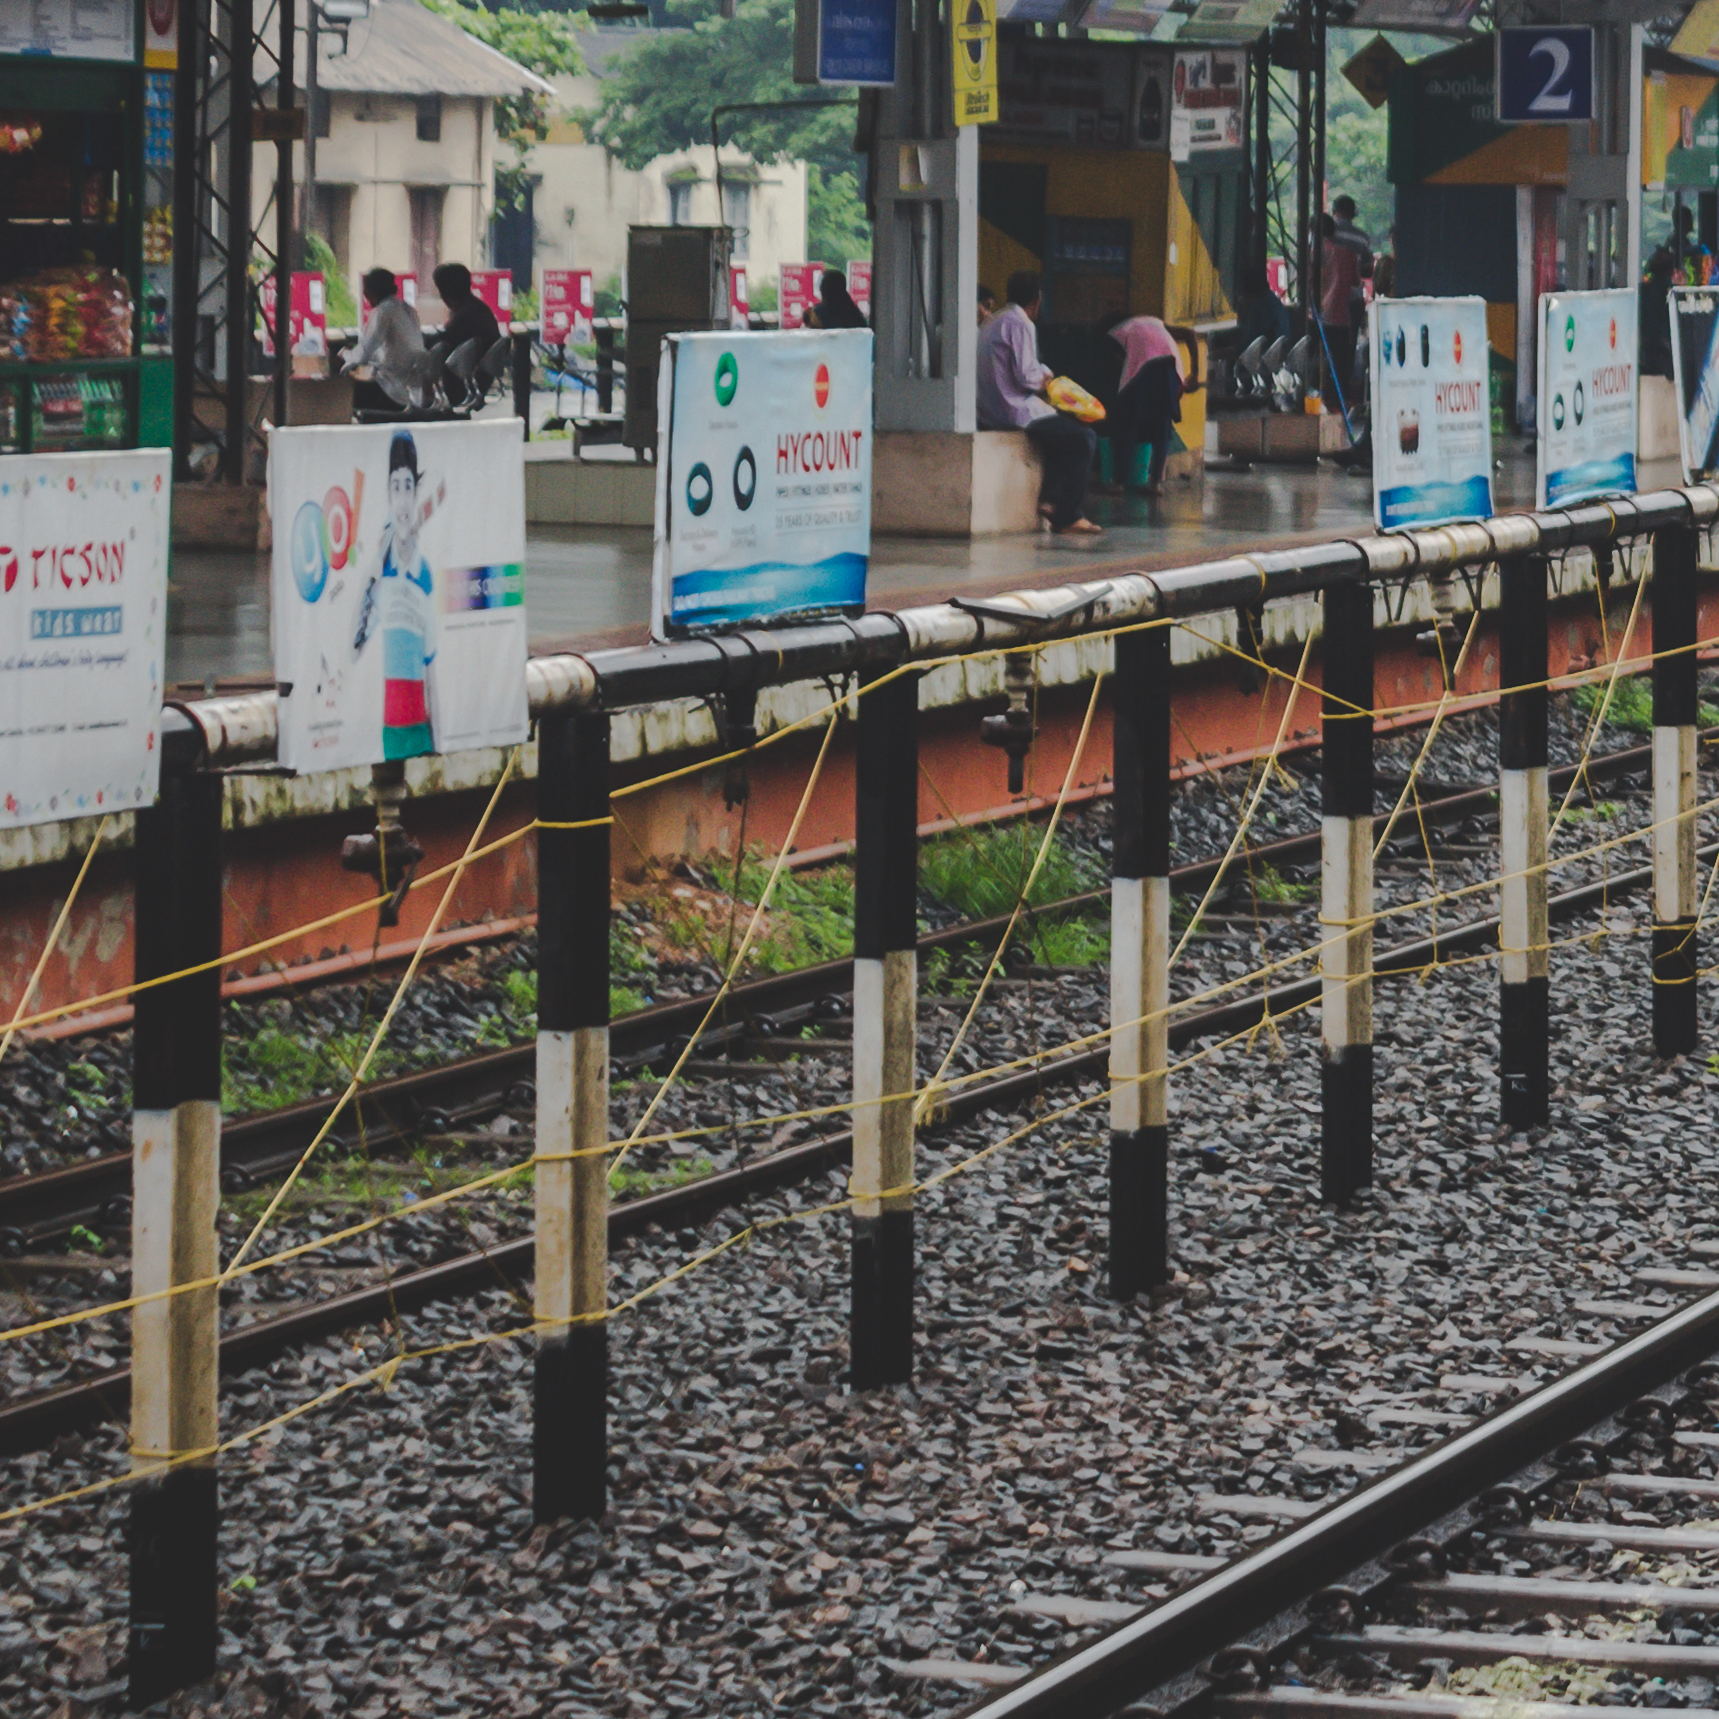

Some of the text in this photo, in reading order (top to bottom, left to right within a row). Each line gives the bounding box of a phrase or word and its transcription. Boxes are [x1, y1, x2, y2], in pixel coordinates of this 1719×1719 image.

[1527, 37, 1573, 111] 2
[1435, 381, 1481, 414] HYCOUNT
[1592, 365, 1632, 398] HYCOUNT
[777, 430, 862, 474] HYCOUNT
[31, 541, 126, 590] TICSON
[34, 610, 121, 637] kids wear
